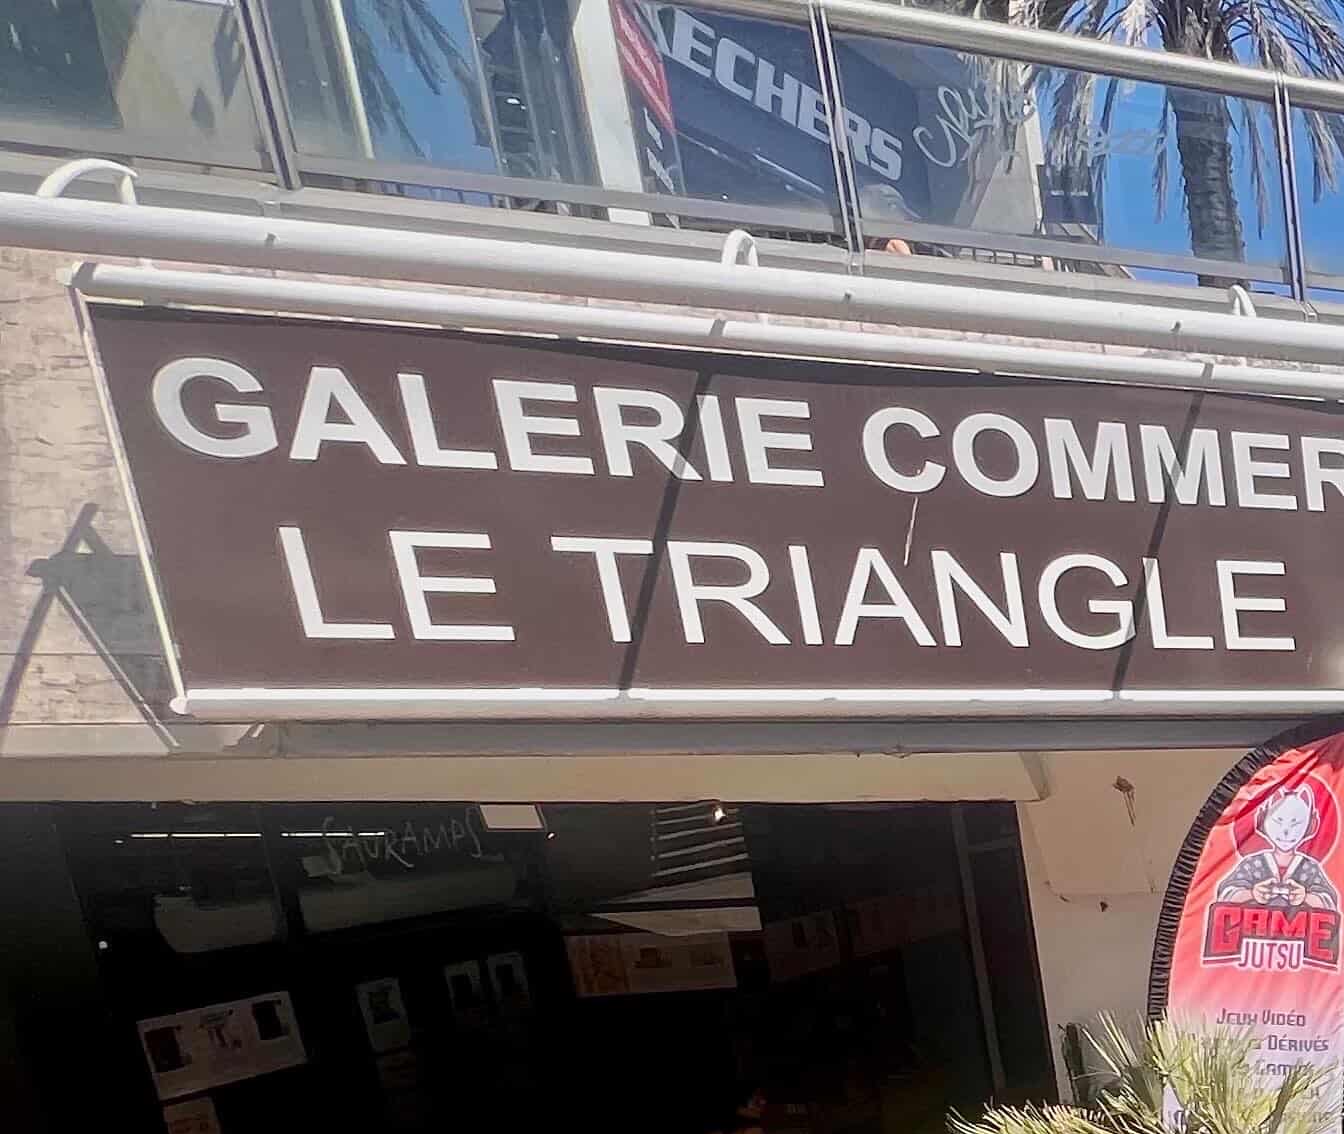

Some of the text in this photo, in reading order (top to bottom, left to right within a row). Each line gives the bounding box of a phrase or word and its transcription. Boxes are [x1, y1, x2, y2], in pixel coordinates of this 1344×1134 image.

[153, 358, 825, 487] GALERIE
[279, 527, 514, 641] LE
[551, 537, 1296, 651] TRIANGLE
[320, 805, 483, 876] SAURAMPS
[1210, 905, 1337, 961] GAME
[1238, 940, 1302, 969] JUTSU
